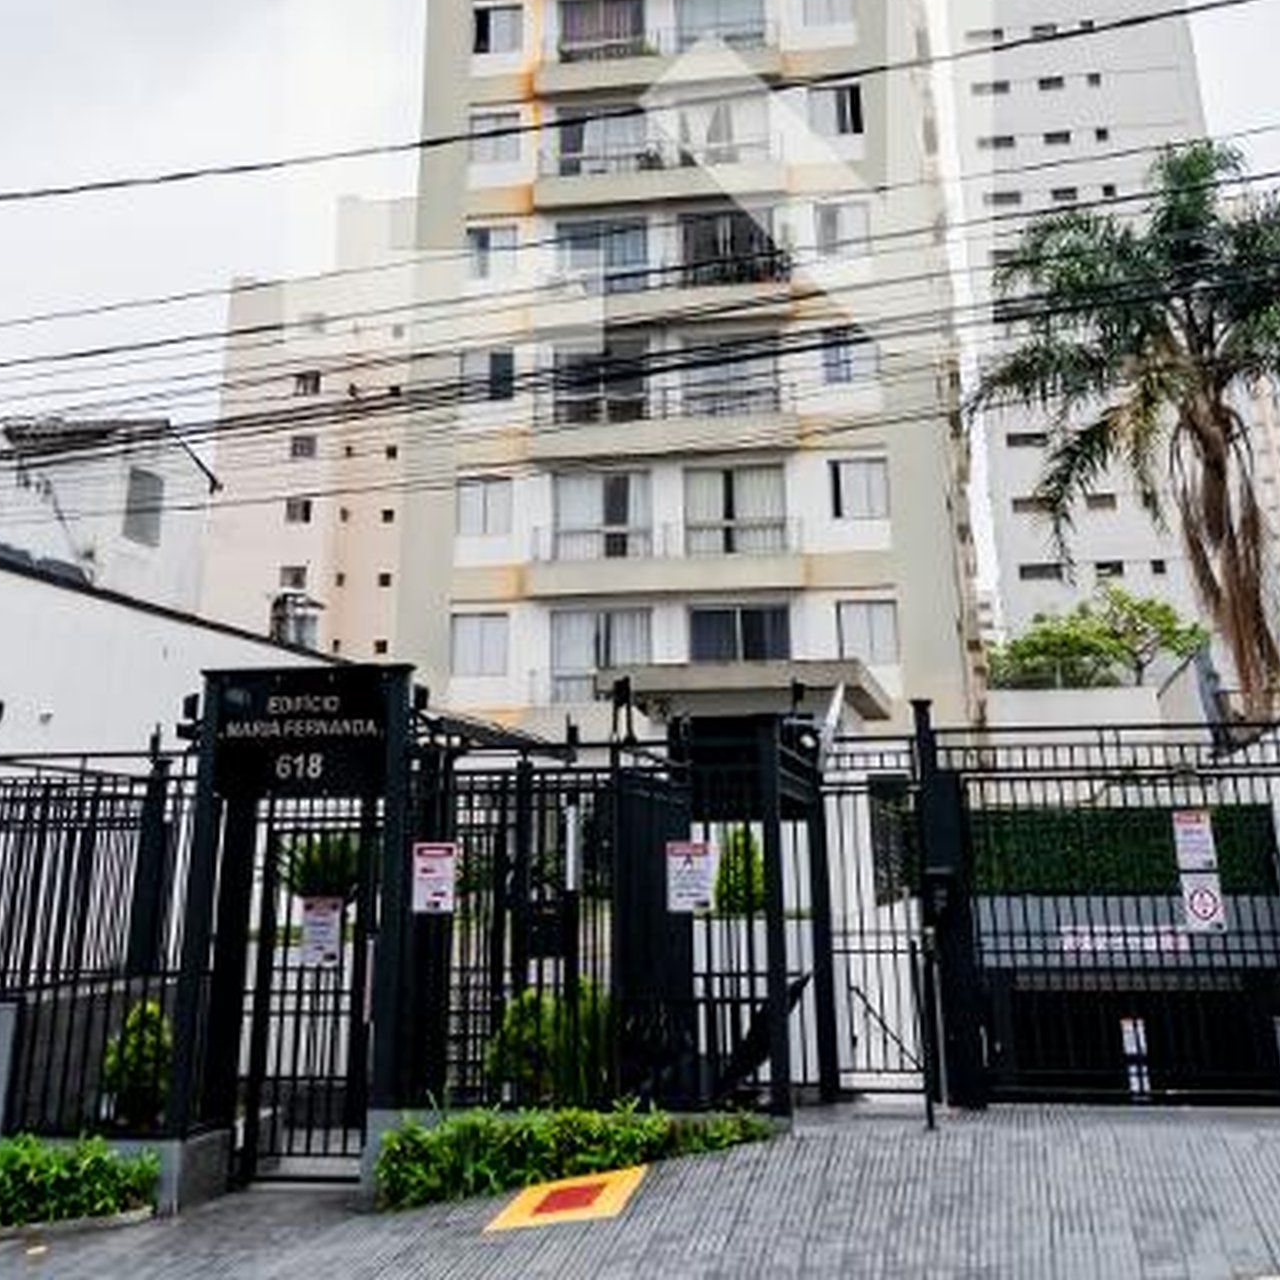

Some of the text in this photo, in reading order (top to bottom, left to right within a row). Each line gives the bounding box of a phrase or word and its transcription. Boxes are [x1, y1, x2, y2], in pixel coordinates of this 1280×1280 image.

[226, 718, 378, 738] MARIA FERNANDA
[275, 753, 323, 779] 618
